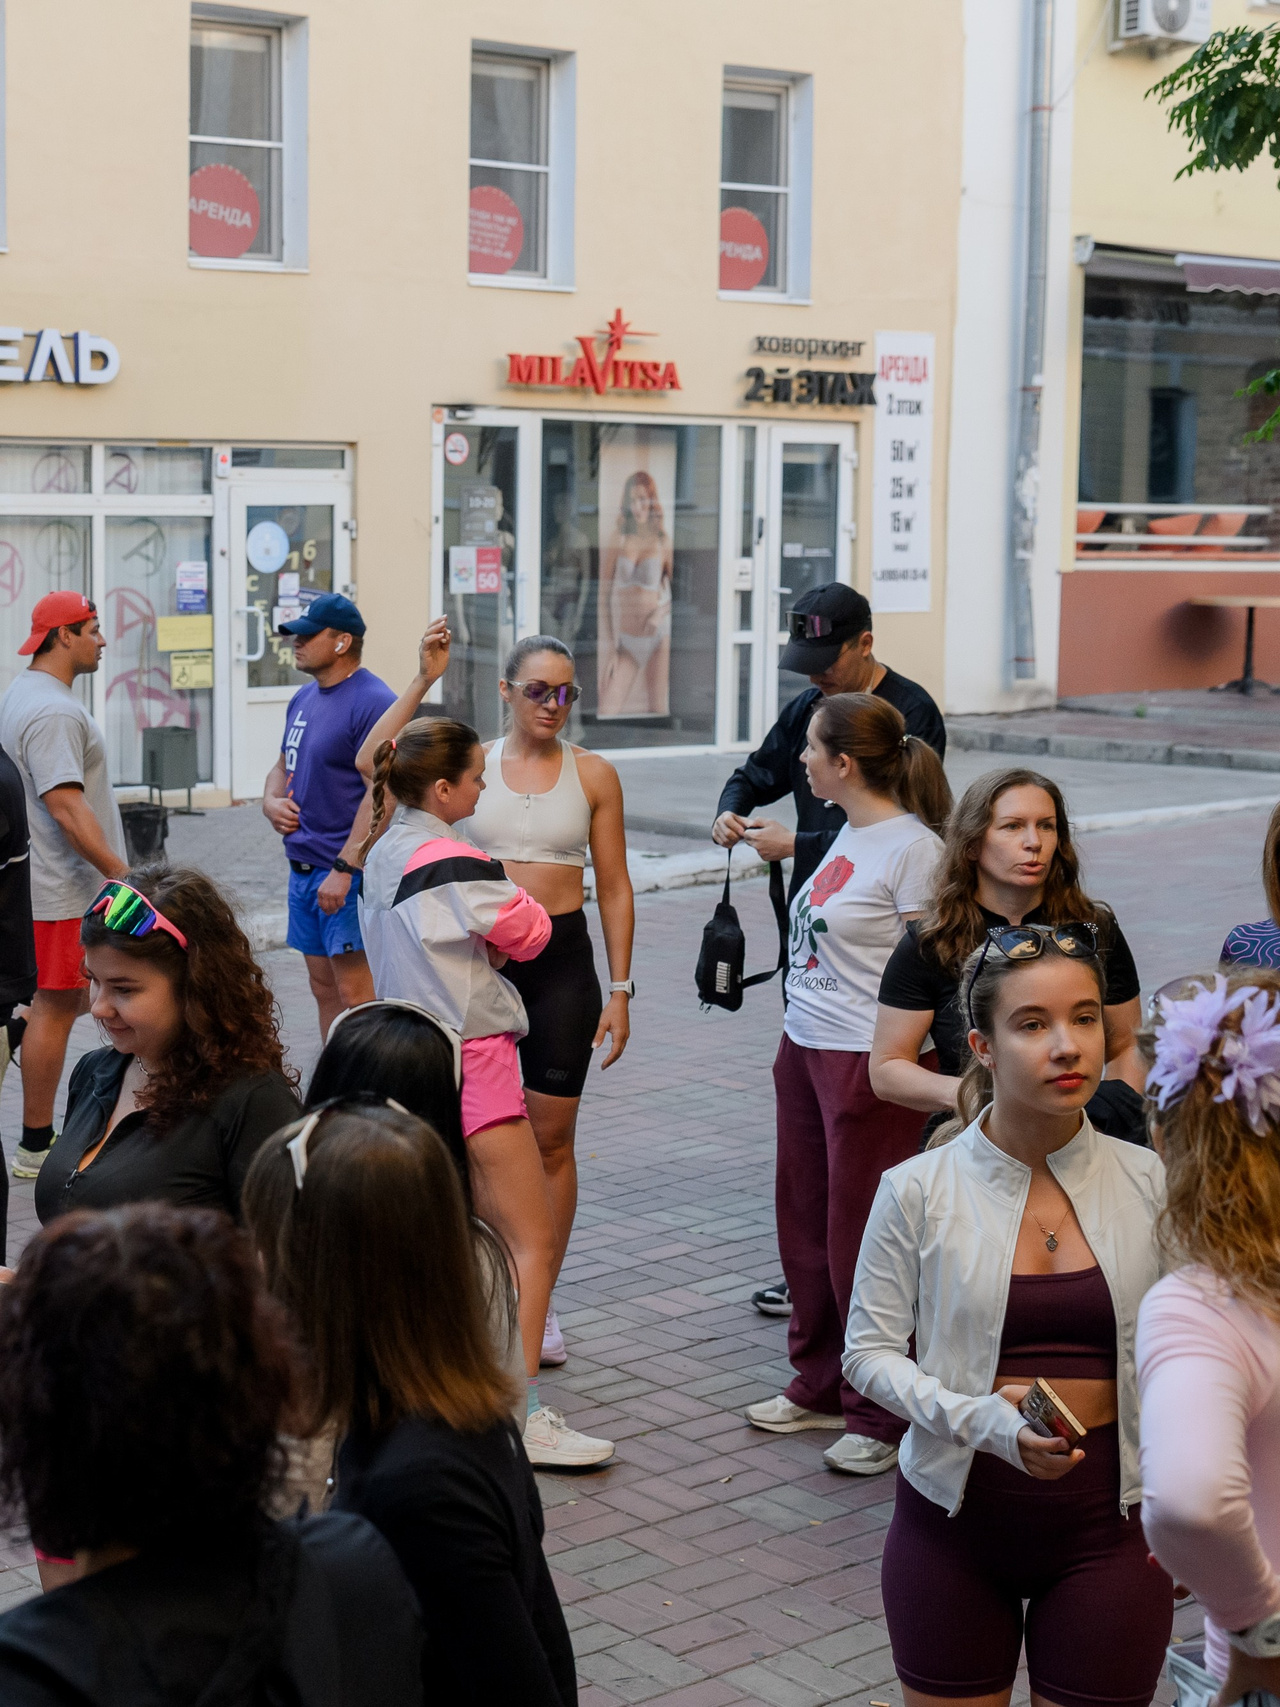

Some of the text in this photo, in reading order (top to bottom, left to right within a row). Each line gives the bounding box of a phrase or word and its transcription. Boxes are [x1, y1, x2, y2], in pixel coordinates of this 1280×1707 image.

[189, 196, 253, 229] АРЕНДА
[507, 334, 682, 395] MILAVITSA
[879, 355, 928, 385] АРЕНДА
[745, 367, 877, 405] 2-й ЭТАЖ
[887, 393, 895, 415] 2
[891, 440, 904, 461] 50
[891, 477, 903, 498] 25
[891, 512, 901, 532] 15
[479, 572, 498, 589] 50
[715, 960, 731, 994] PUMA
[804, 975, 839, 992] ROSES
